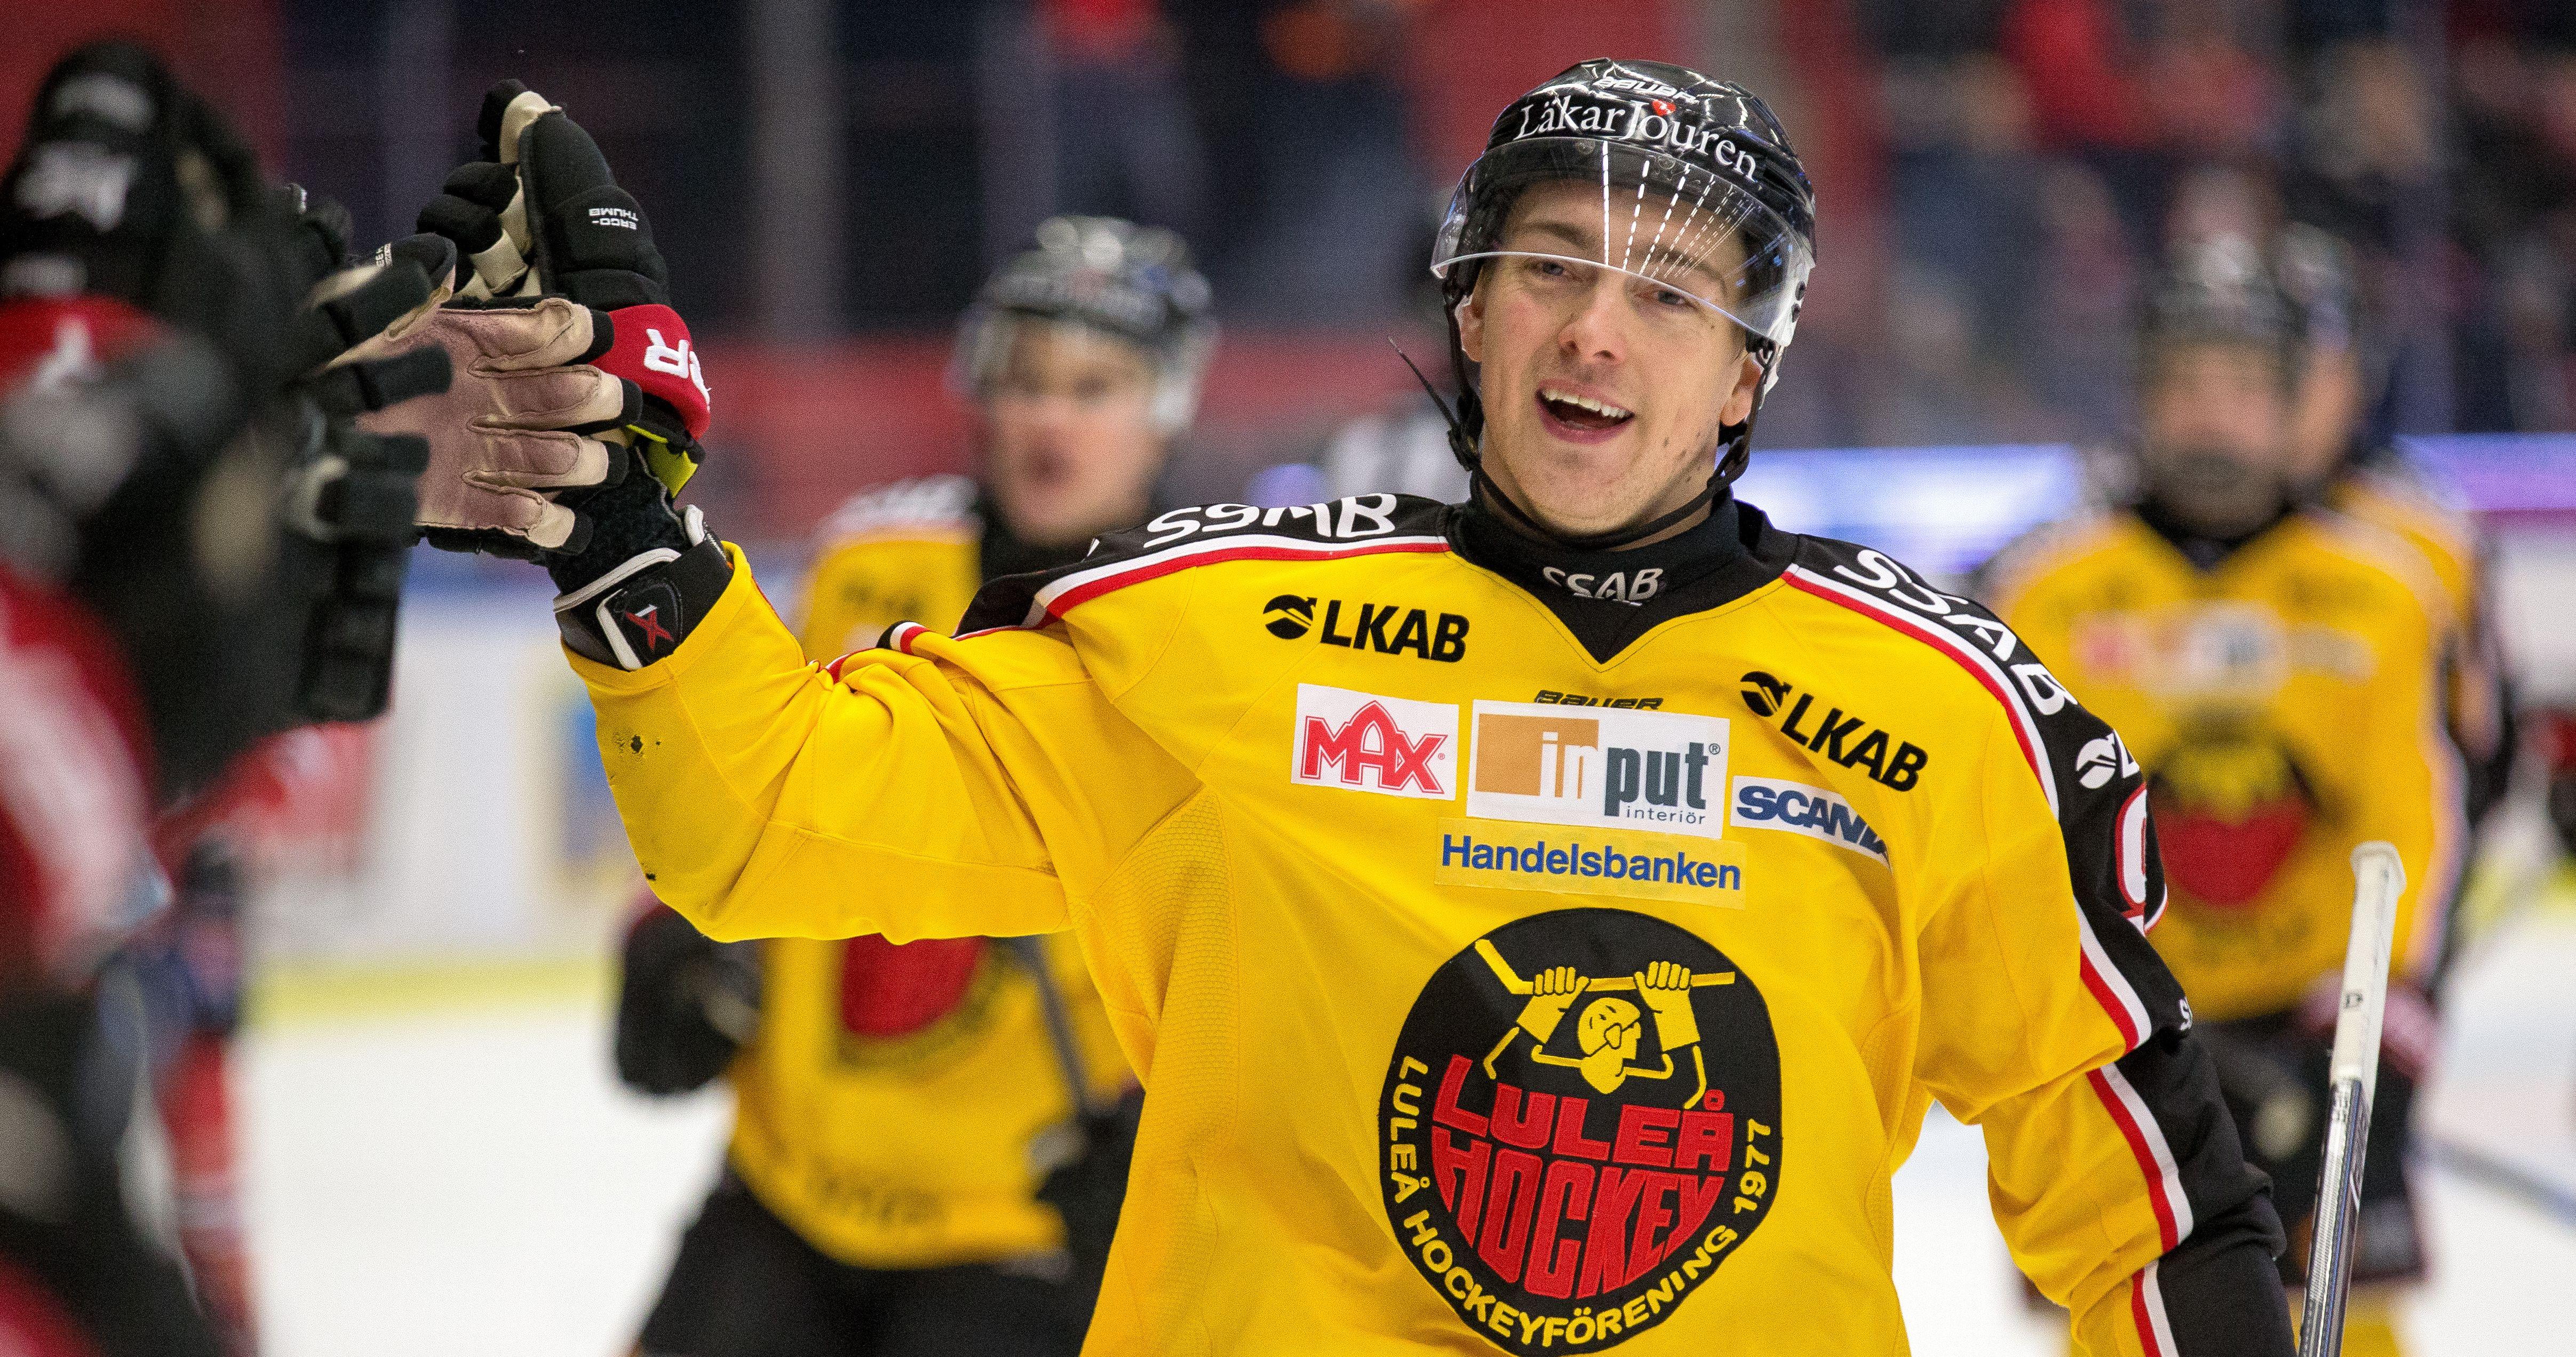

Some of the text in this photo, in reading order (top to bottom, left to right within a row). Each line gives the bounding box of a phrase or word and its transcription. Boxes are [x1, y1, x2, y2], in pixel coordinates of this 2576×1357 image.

[1514, 95, 1759, 181] LäkarJouren
[1321, 600, 1470, 663] LKAB
[1300, 700, 1448, 794] MAX
[1540, 732, 1709, 816] input
[1780, 693, 1929, 792] LKAB
[1626, 805, 1706, 824] interiör
[1442, 834, 1740, 891] Handelsbanken
[1433, 1054, 1734, 1172] LULEÅ
[1390, 1056, 1771, 1347] LULEÅ HOCKEYFÖRENING 1977
[1432, 1126, 1724, 1300] HOCKEY
